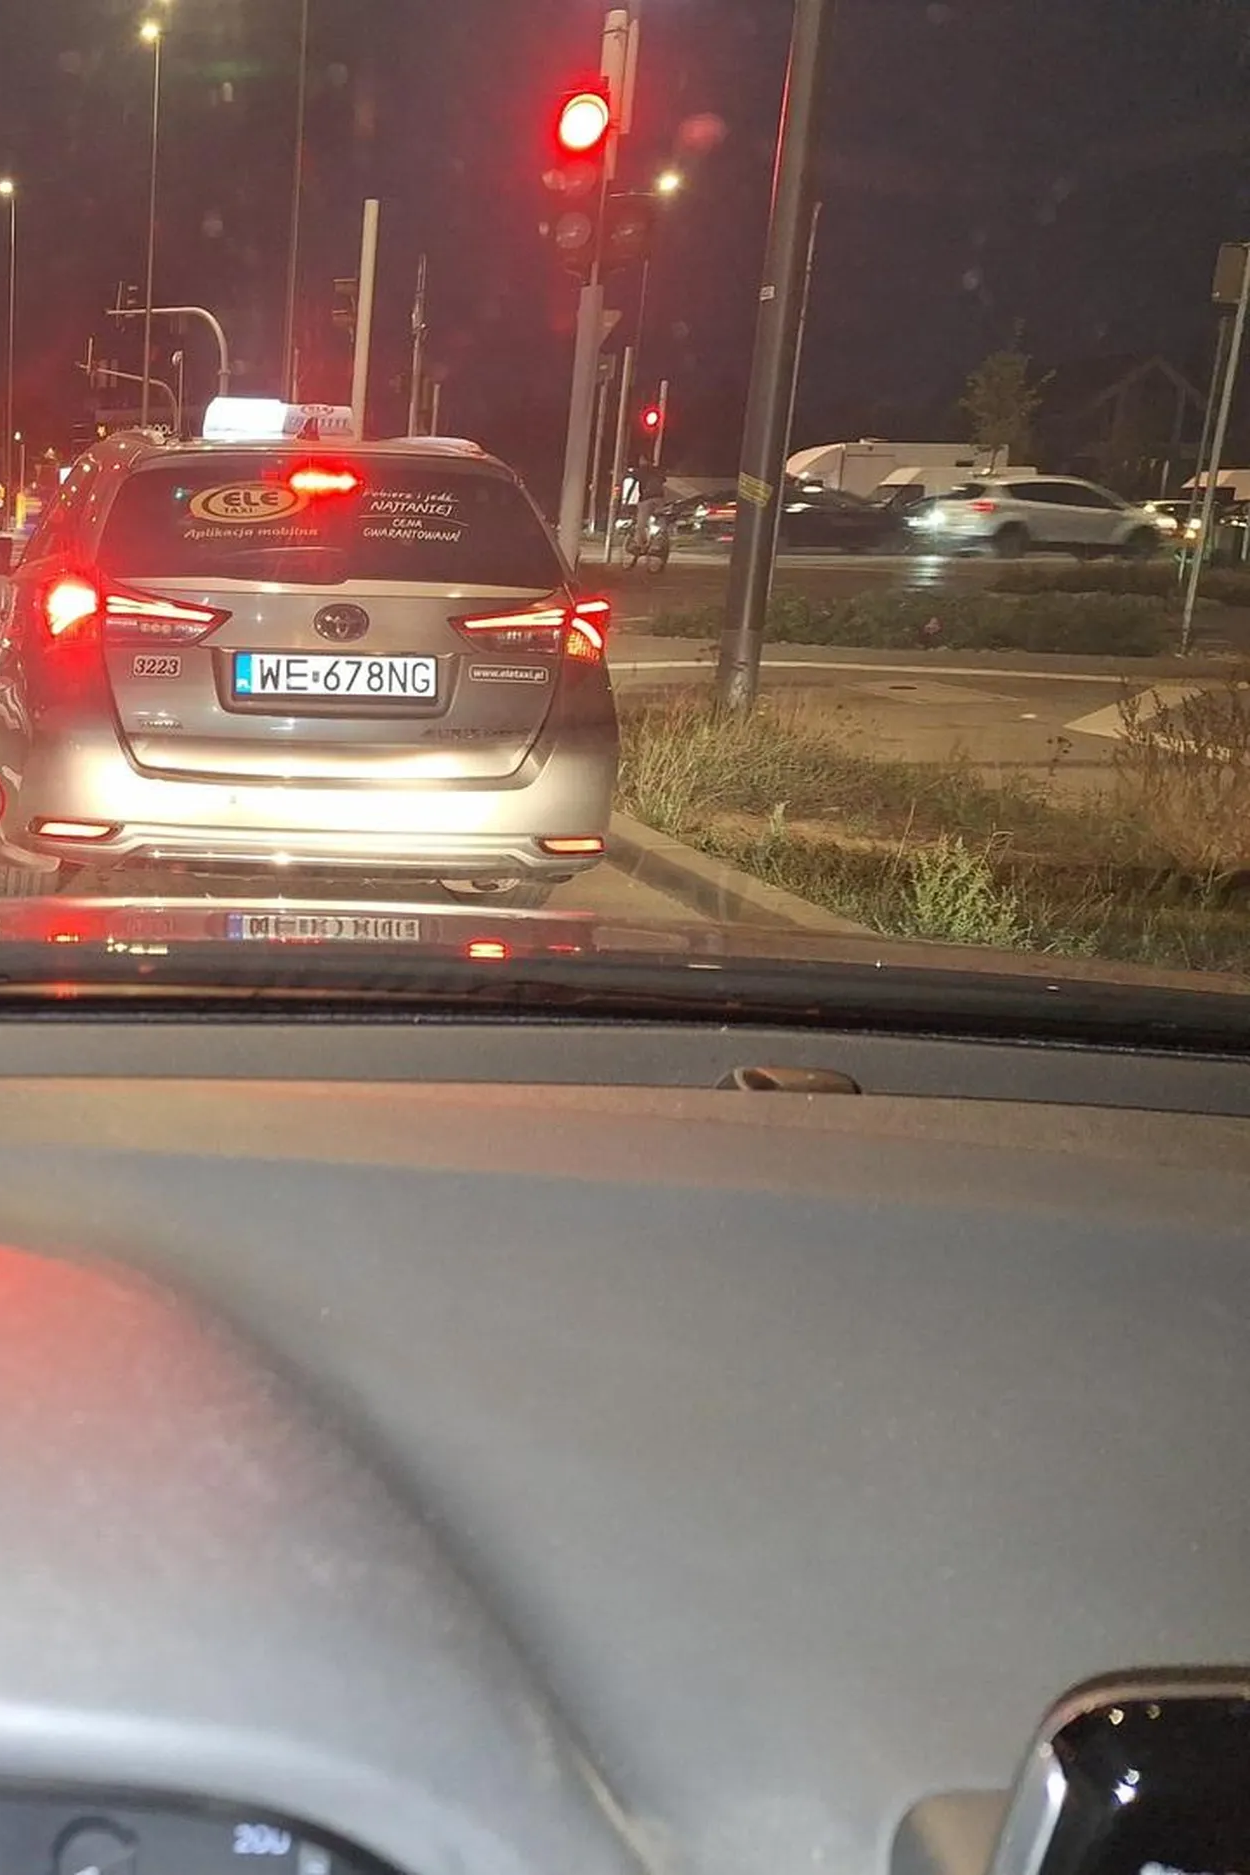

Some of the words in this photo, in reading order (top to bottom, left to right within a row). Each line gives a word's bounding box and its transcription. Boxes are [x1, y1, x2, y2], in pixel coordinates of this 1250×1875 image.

[223, 491, 278, 506] ELE
[371, 501, 452, 516] NAJTANIEJ
[392, 519, 423, 528] CENA
[183, 528, 253, 540] Aplikacja
[258, 527, 318, 536] mobilna
[363, 528, 461, 542] GWARANTOWANA!
[135, 658, 178, 675] 3223
[260, 659, 308, 691] WE
[324, 660, 430, 693] 678NG
[472, 667, 546, 681] www.eletaxi.pl
